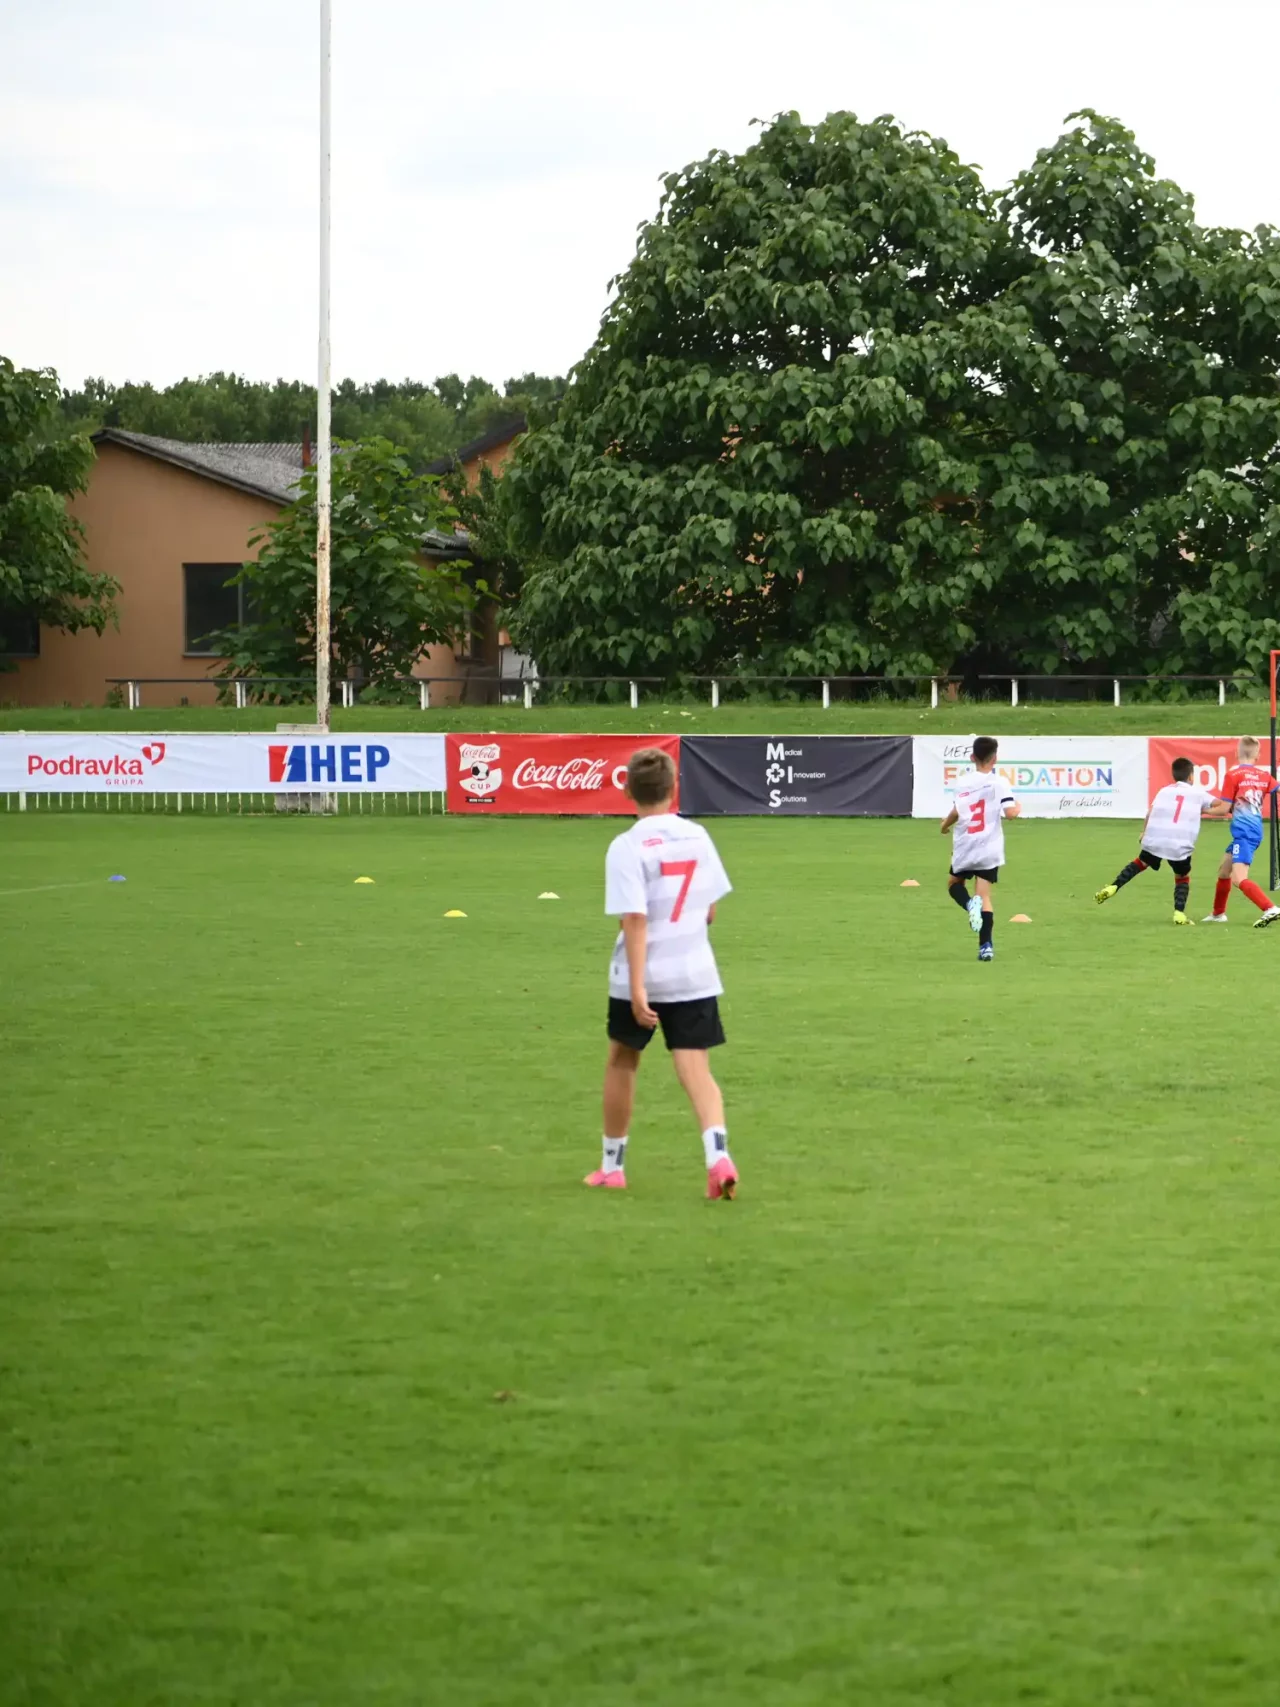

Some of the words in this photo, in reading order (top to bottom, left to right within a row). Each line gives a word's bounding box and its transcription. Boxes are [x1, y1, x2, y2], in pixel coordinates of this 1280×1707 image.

[766, 742, 803, 761] Medical
[943, 744, 974, 758] UEF
[27, 754, 144, 776] Podravka
[311, 745, 391, 782] HEP
[512, 757, 608, 790] Coca-Cola
[105, 778, 144, 786] GRUPA
[787, 765, 826, 784] Innovation
[943, 767, 1113, 787] FNDATION
[768, 789, 807, 808] Solutions
[1059, 796, 1072, 811] for
[1075, 796, 1113, 808] children
[967, 798, 985, 834] 3
[1173, 795, 1184, 824] 1
[660, 860, 697, 923] 7
